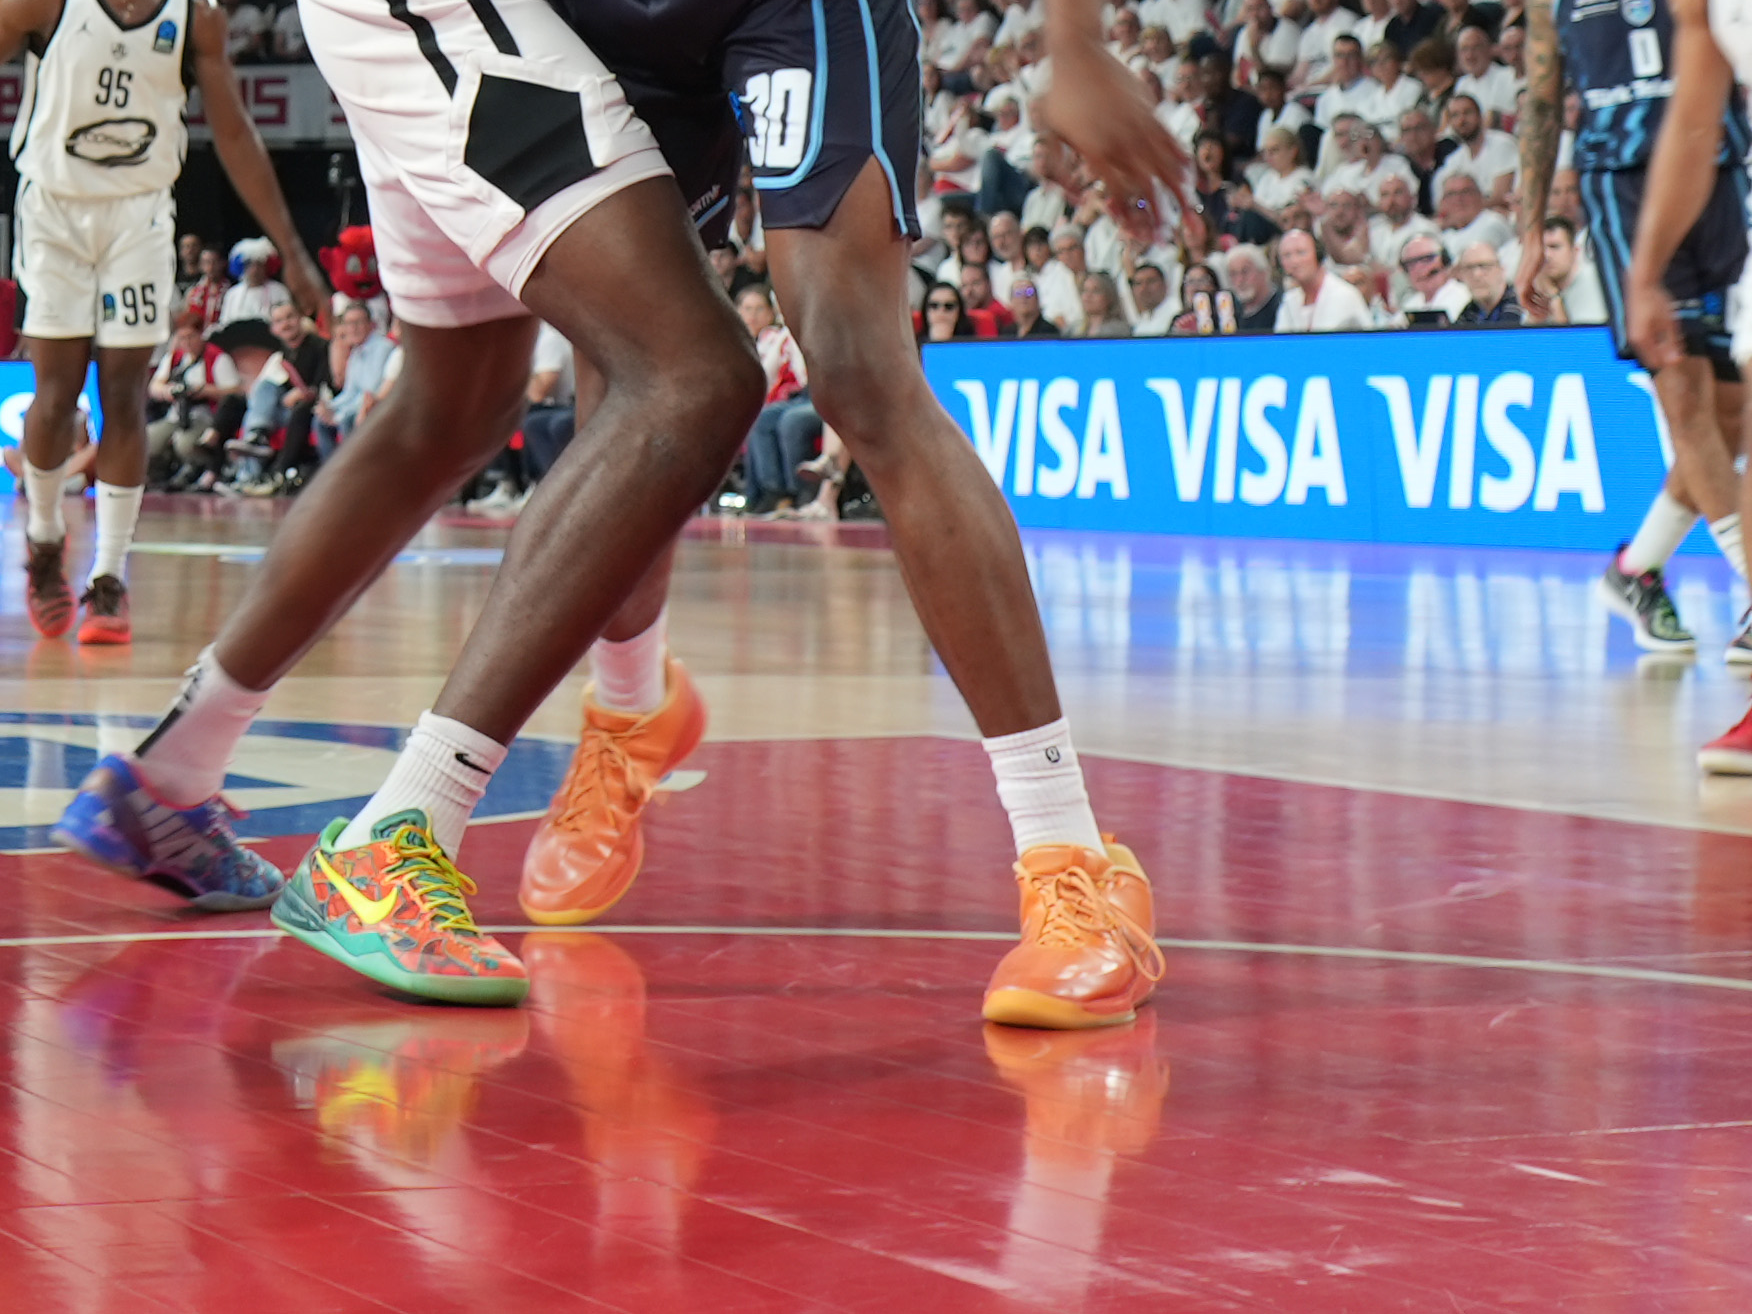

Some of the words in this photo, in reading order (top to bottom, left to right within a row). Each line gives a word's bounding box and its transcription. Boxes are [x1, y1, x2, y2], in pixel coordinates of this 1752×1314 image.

[94, 65, 134, 110] 95
[738, 67, 812, 168] 30
[121, 282, 159, 327] 95
[954, 376, 1129, 499] VISA
[1145, 376, 1347, 506] VISA
[1367, 373, 1605, 515] VISA
